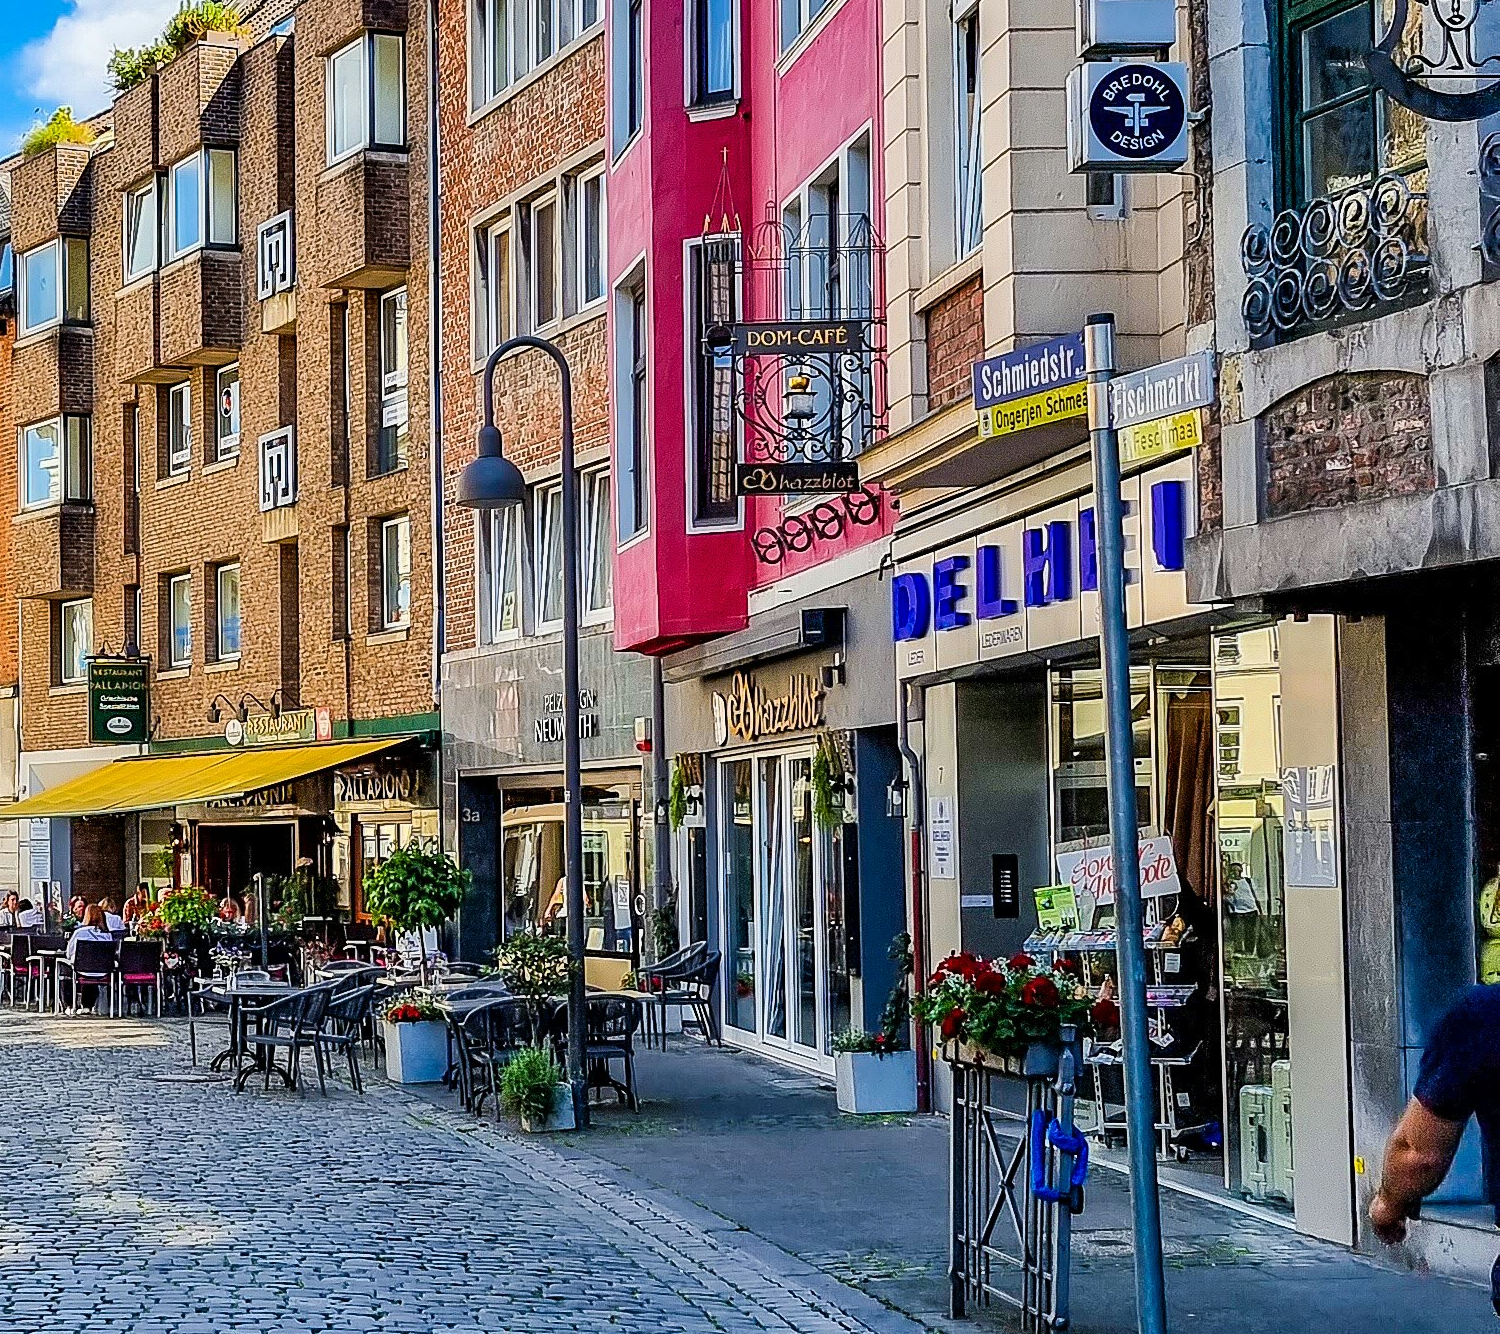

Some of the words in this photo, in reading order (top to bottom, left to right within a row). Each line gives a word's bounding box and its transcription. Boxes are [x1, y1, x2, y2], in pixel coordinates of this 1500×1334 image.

[1102, 73, 1170, 102] BREDOHL
[1110, 129, 1165, 150] DESIGN
[747, 326, 849, 346] DOM-CAFÉ
[981, 344, 1084, 401] Schmiedstr.
[1113, 363, 1201, 425] Fischmarkt
[995, 402, 1043, 431] Ongerjen
[92, 668, 143, 677] RESTAURANT
[247, 712, 308, 735] RESTAURANT
[462, 808, 481, 822] 3a
